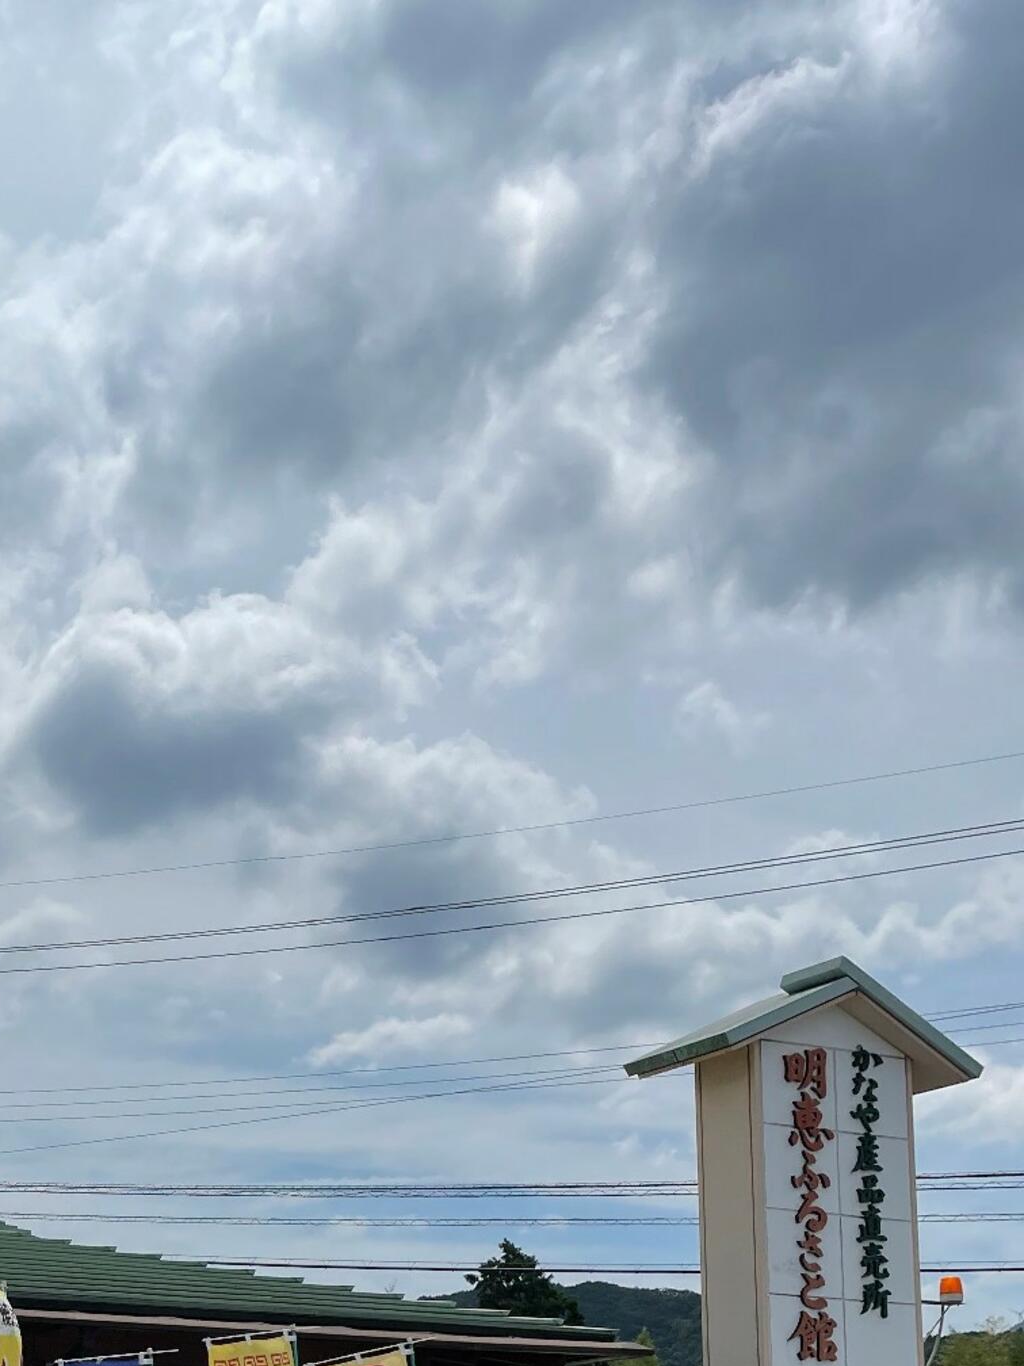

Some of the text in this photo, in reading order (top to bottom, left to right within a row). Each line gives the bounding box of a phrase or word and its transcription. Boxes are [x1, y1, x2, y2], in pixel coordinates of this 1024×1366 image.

[782, 1046, 838, 1362] 明恵ふるさと館
[848, 1044, 891, 1319] かなや産品直売所
